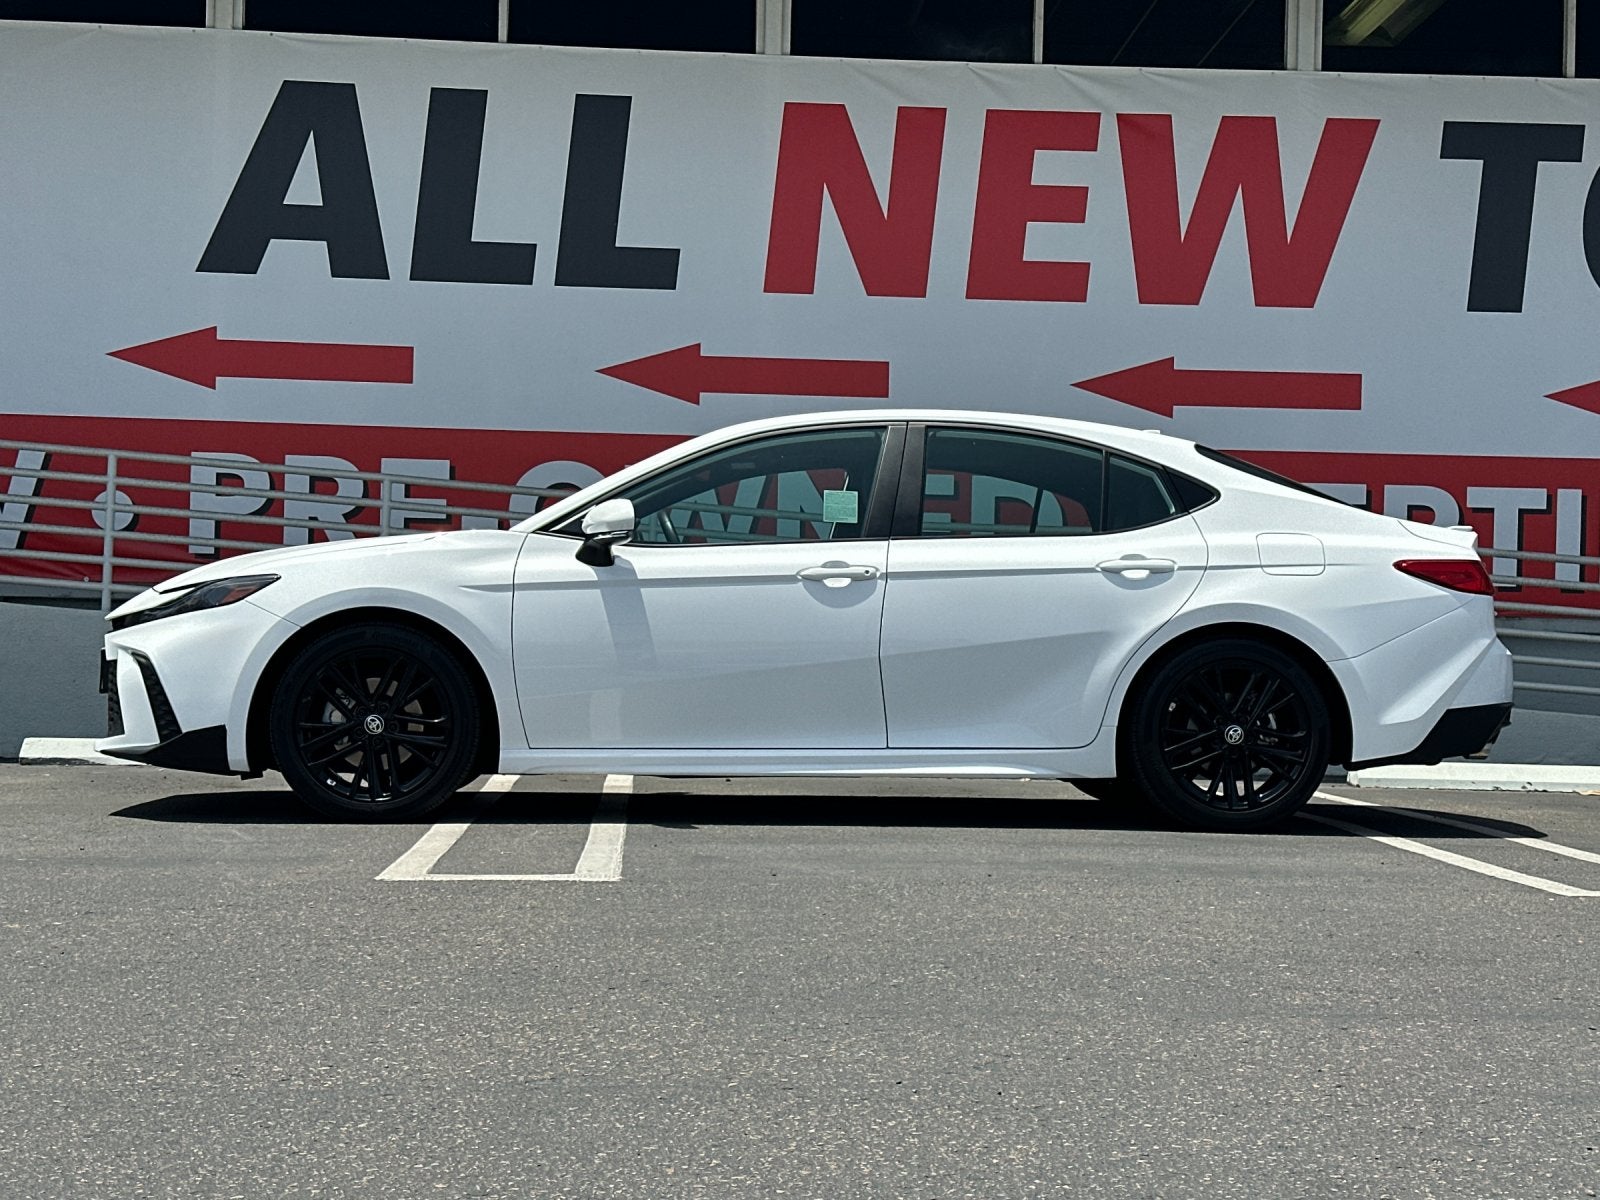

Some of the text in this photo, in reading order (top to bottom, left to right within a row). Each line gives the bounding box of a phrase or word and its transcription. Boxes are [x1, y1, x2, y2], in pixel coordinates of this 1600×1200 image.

[196, 79, 1600, 313] ALL NEW T
